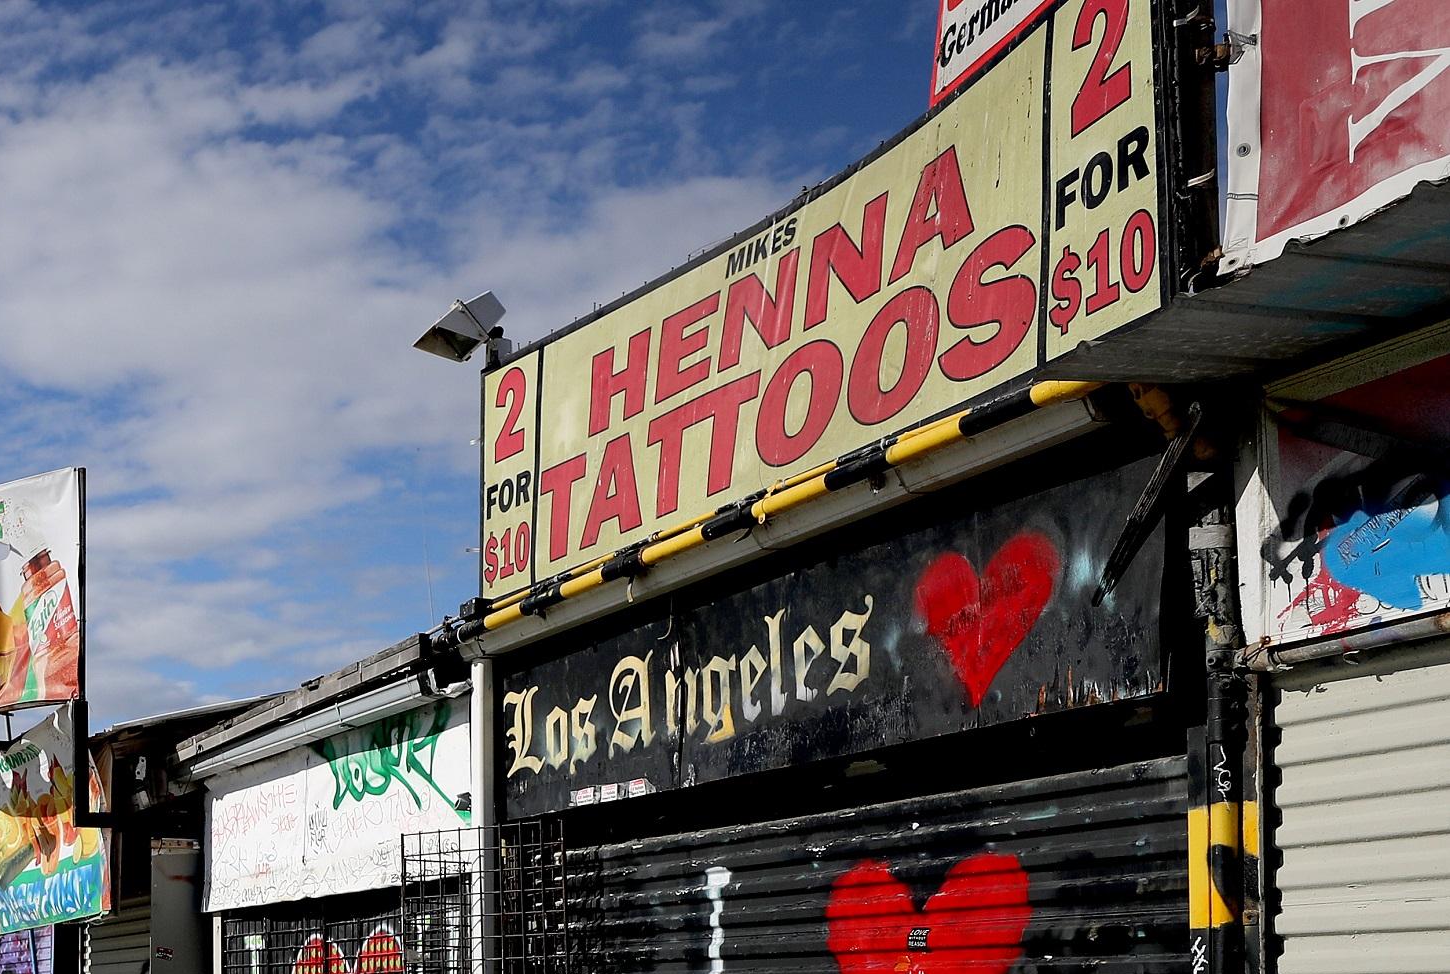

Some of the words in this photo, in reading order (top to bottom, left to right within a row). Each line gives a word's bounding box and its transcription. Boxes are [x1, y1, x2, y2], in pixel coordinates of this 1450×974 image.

[937, 0, 1022, 68] Germa
[1070, 0, 1133, 138] 2
[1055, 125, 1150, 232] FOR
[588, 145, 974, 437] HENNA
[725, 217, 798, 279] MIKES
[1049, 208, 1157, 335] $10
[494, 366, 527, 464] 2
[540, 224, 1038, 563] TATTOOS
[486, 469, 531, 520] FOR
[483, 520, 531, 589] $10
[503, 684, 598, 778] Los
[607, 594, 874, 760] Angeles
